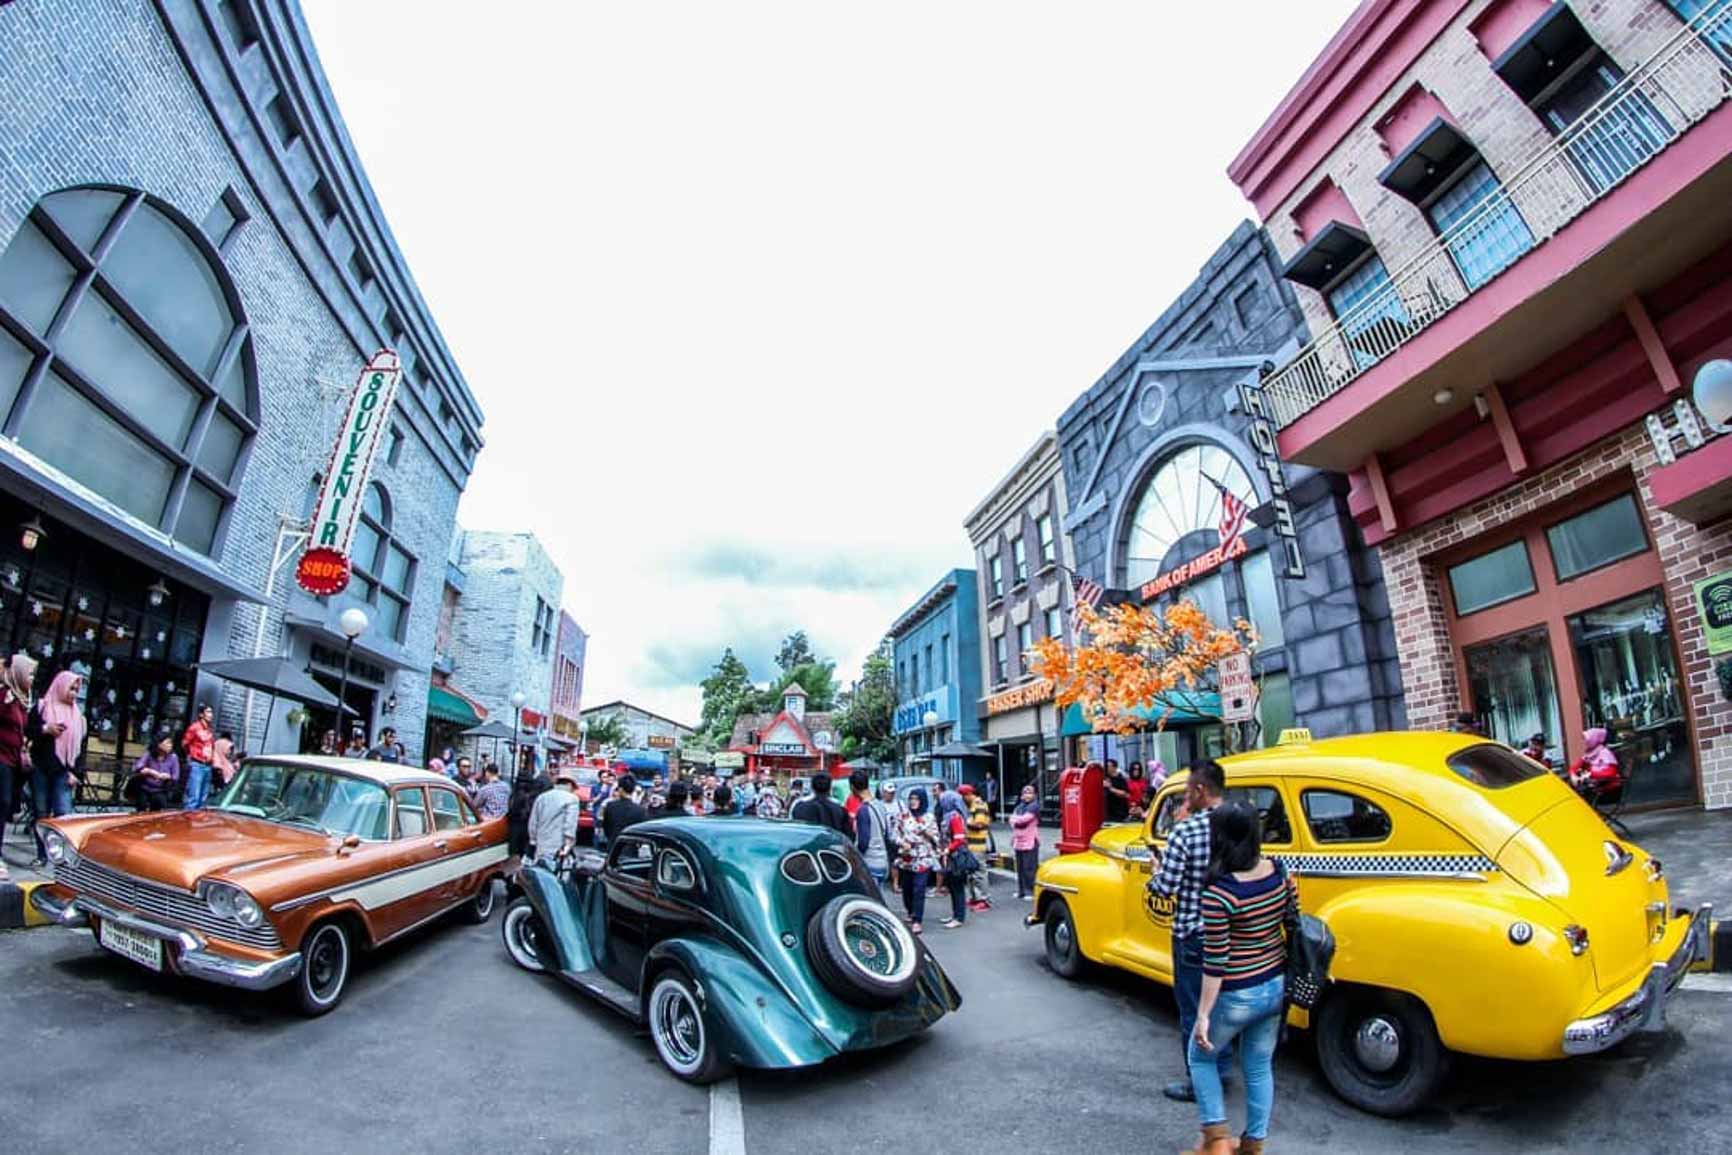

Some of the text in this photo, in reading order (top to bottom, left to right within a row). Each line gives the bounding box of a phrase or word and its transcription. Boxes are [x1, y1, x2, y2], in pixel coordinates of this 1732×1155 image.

[320, 373, 384, 545] SOUVENIR
[1237, 384, 1306, 579] HOTEL
[301, 560, 343, 579] SHOP
[1141, 536, 1247, 600] BANK OF AMERA
[1226, 658, 1239, 671] NO
[1023, 679, 1054, 704] SHOP
[765, 744, 805, 754] SINCLAIR
[1151, 895, 1174, 914] TAXI
